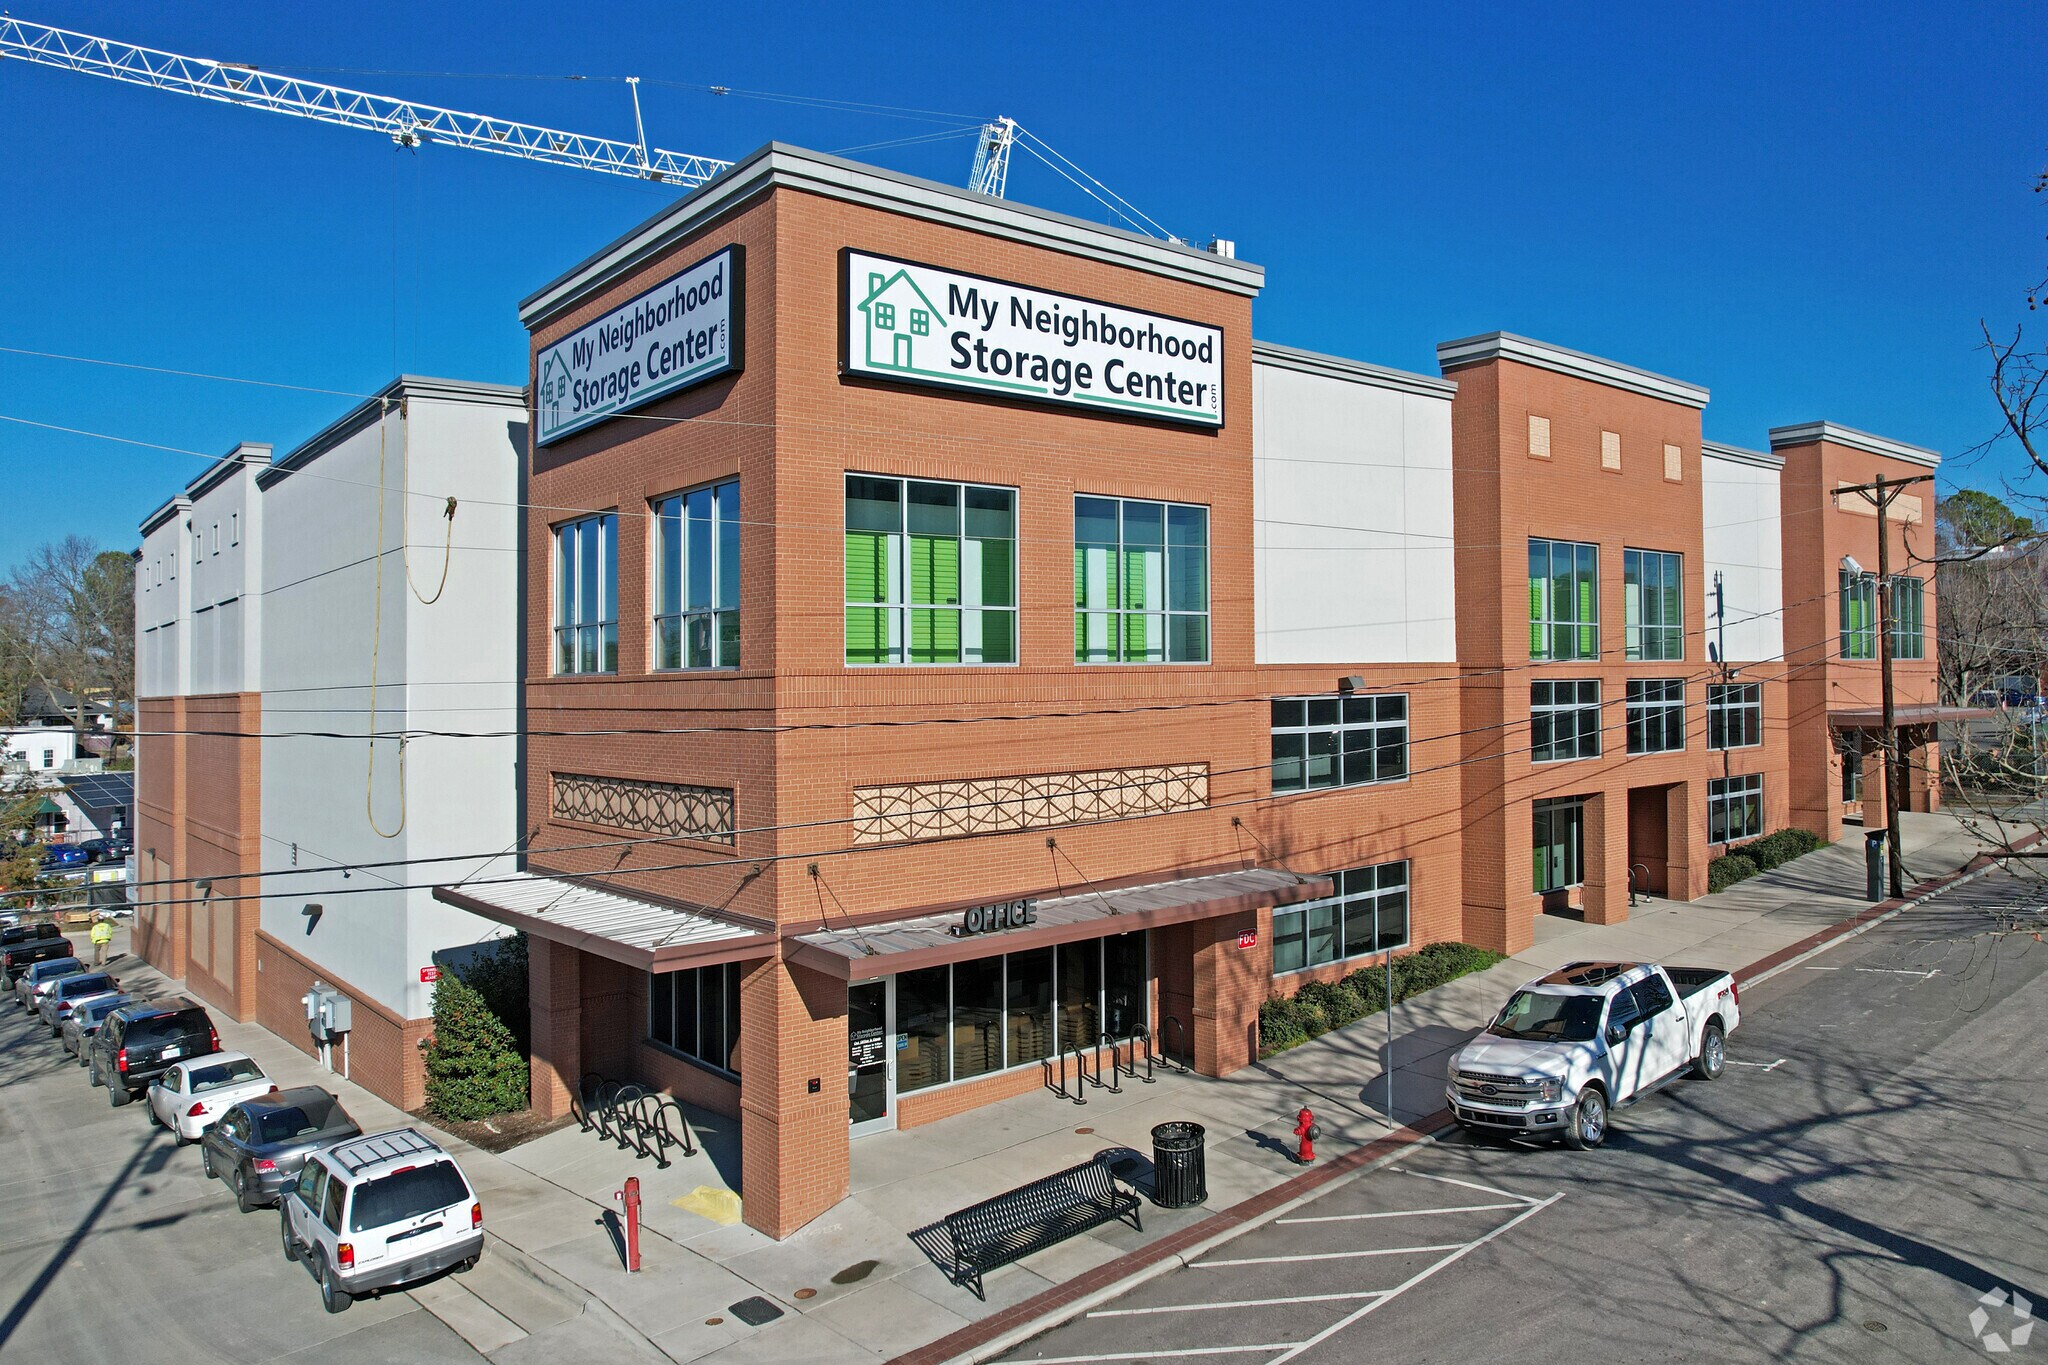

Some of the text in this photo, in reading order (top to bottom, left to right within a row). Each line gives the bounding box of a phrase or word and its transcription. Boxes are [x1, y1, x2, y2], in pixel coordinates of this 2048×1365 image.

[572, 261, 724, 372] My Neighborhood
[948, 283, 1213, 364] My Neighborhood
[572, 323, 718, 414] Storage Center
[950, 331, 1207, 407] Storage Center
[964, 898, 1038, 934] OFFICE
[1239, 932, 1255, 945] FDC
